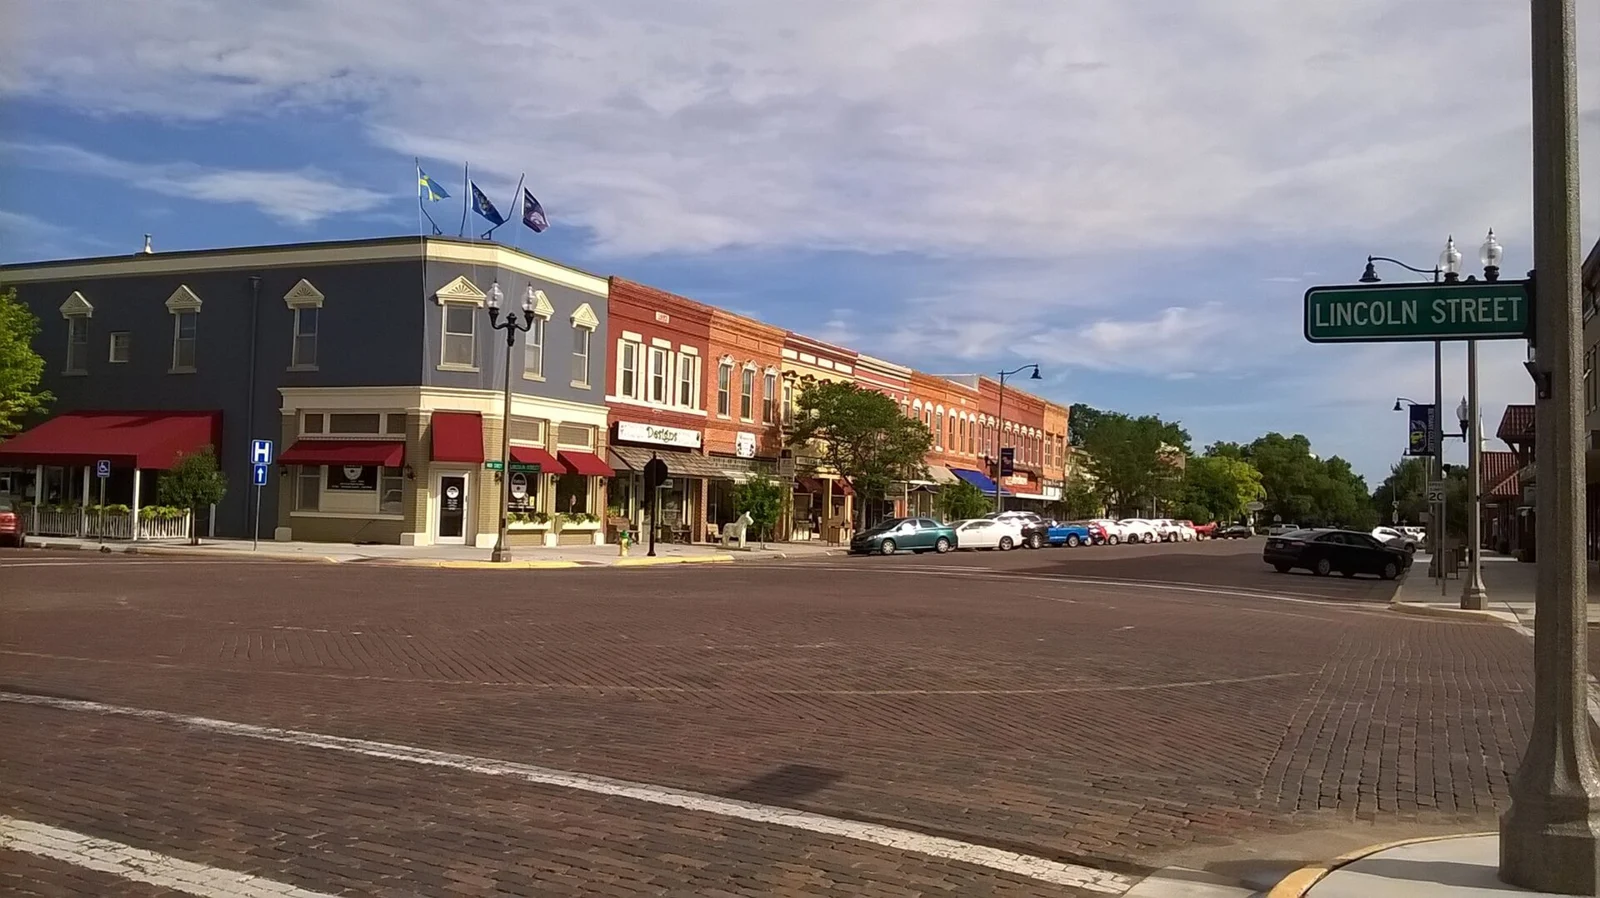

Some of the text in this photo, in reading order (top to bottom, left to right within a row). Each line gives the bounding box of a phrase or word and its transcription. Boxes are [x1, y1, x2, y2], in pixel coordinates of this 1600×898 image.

[1315, 297, 1522, 327] LINCOLN STREET
[646, 426, 678, 443] Designs
[254, 441, 269, 462] H
